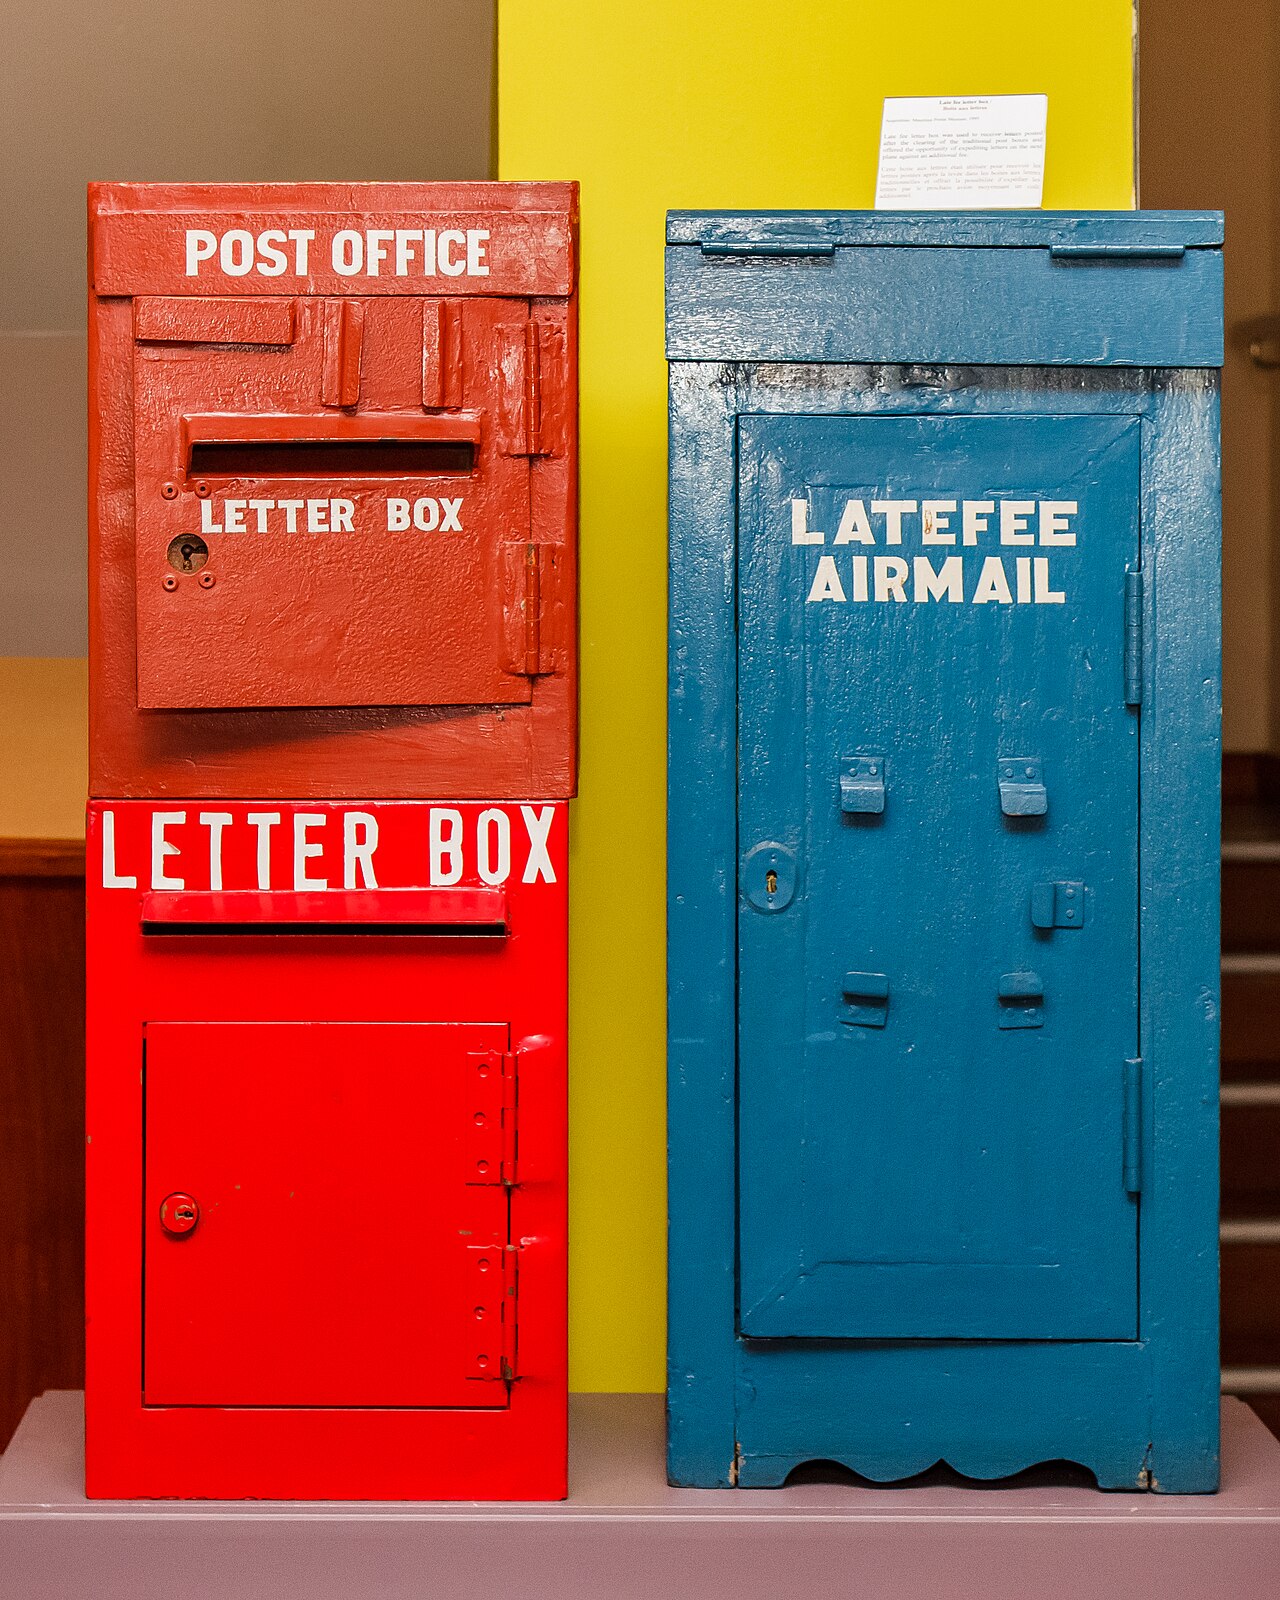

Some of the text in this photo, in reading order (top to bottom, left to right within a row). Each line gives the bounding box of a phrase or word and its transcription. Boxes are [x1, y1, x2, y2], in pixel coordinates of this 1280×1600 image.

[186, 228, 491, 277] POST OFFICE
[201, 498, 464, 533] LETTER BOX
[807, 556, 1065, 603] AIRMAIL
[103, 806, 556, 891] LETTER BOX
